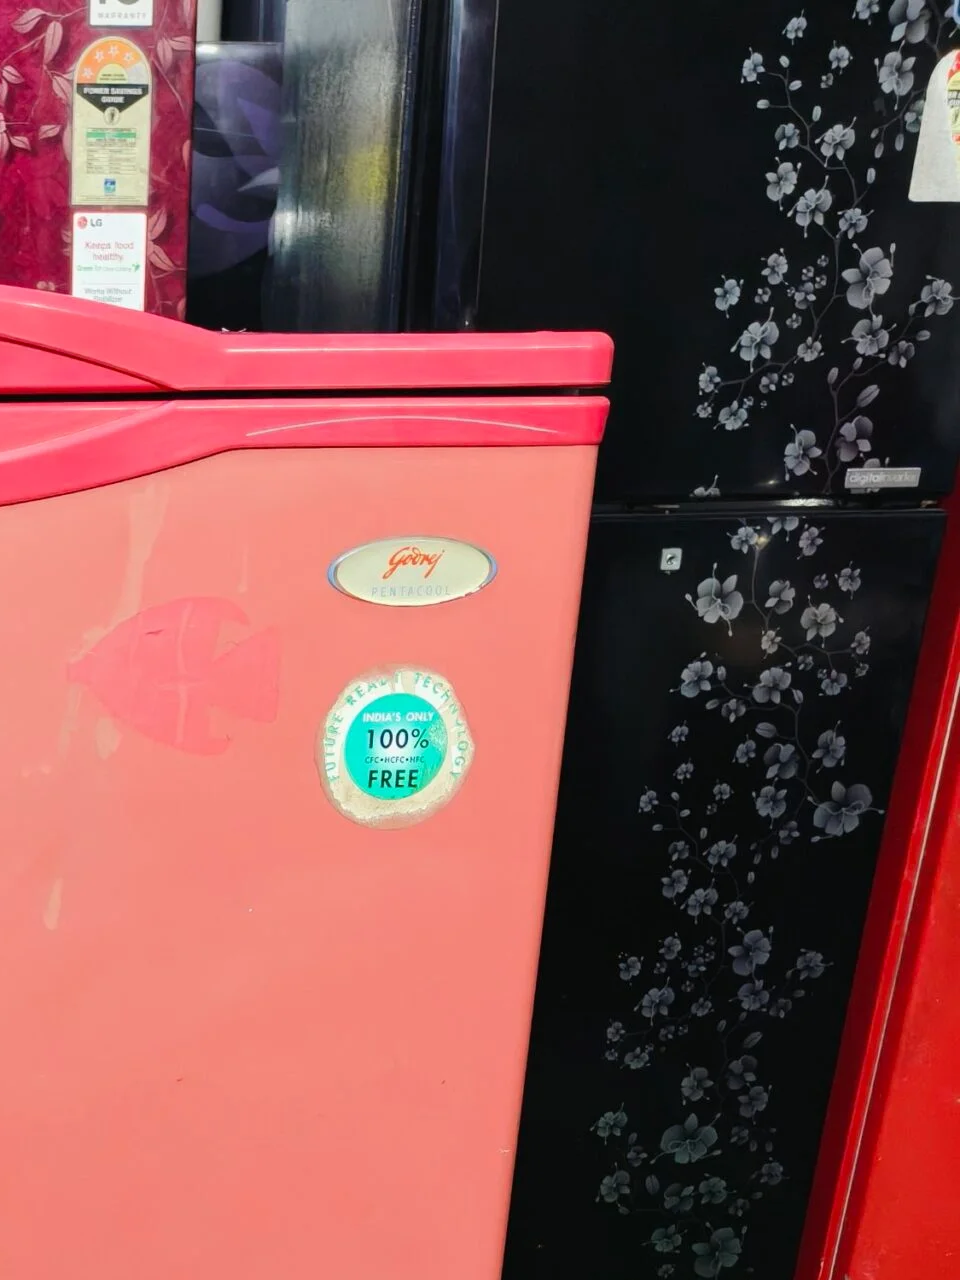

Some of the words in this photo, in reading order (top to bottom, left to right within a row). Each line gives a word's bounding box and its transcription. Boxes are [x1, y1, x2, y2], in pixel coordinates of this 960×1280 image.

[90, 218, 103, 228] LG
[114, 241, 135, 250] food
[382, 547, 445, 580] Godrej
[371, 585, 451, 597] PENTACOOL
[362, 711, 401, 723] INDIA'S
[405, 711, 435, 722] ONLY
[367, 728, 430, 749] 100%
[367, 768, 419, 789] FREE
